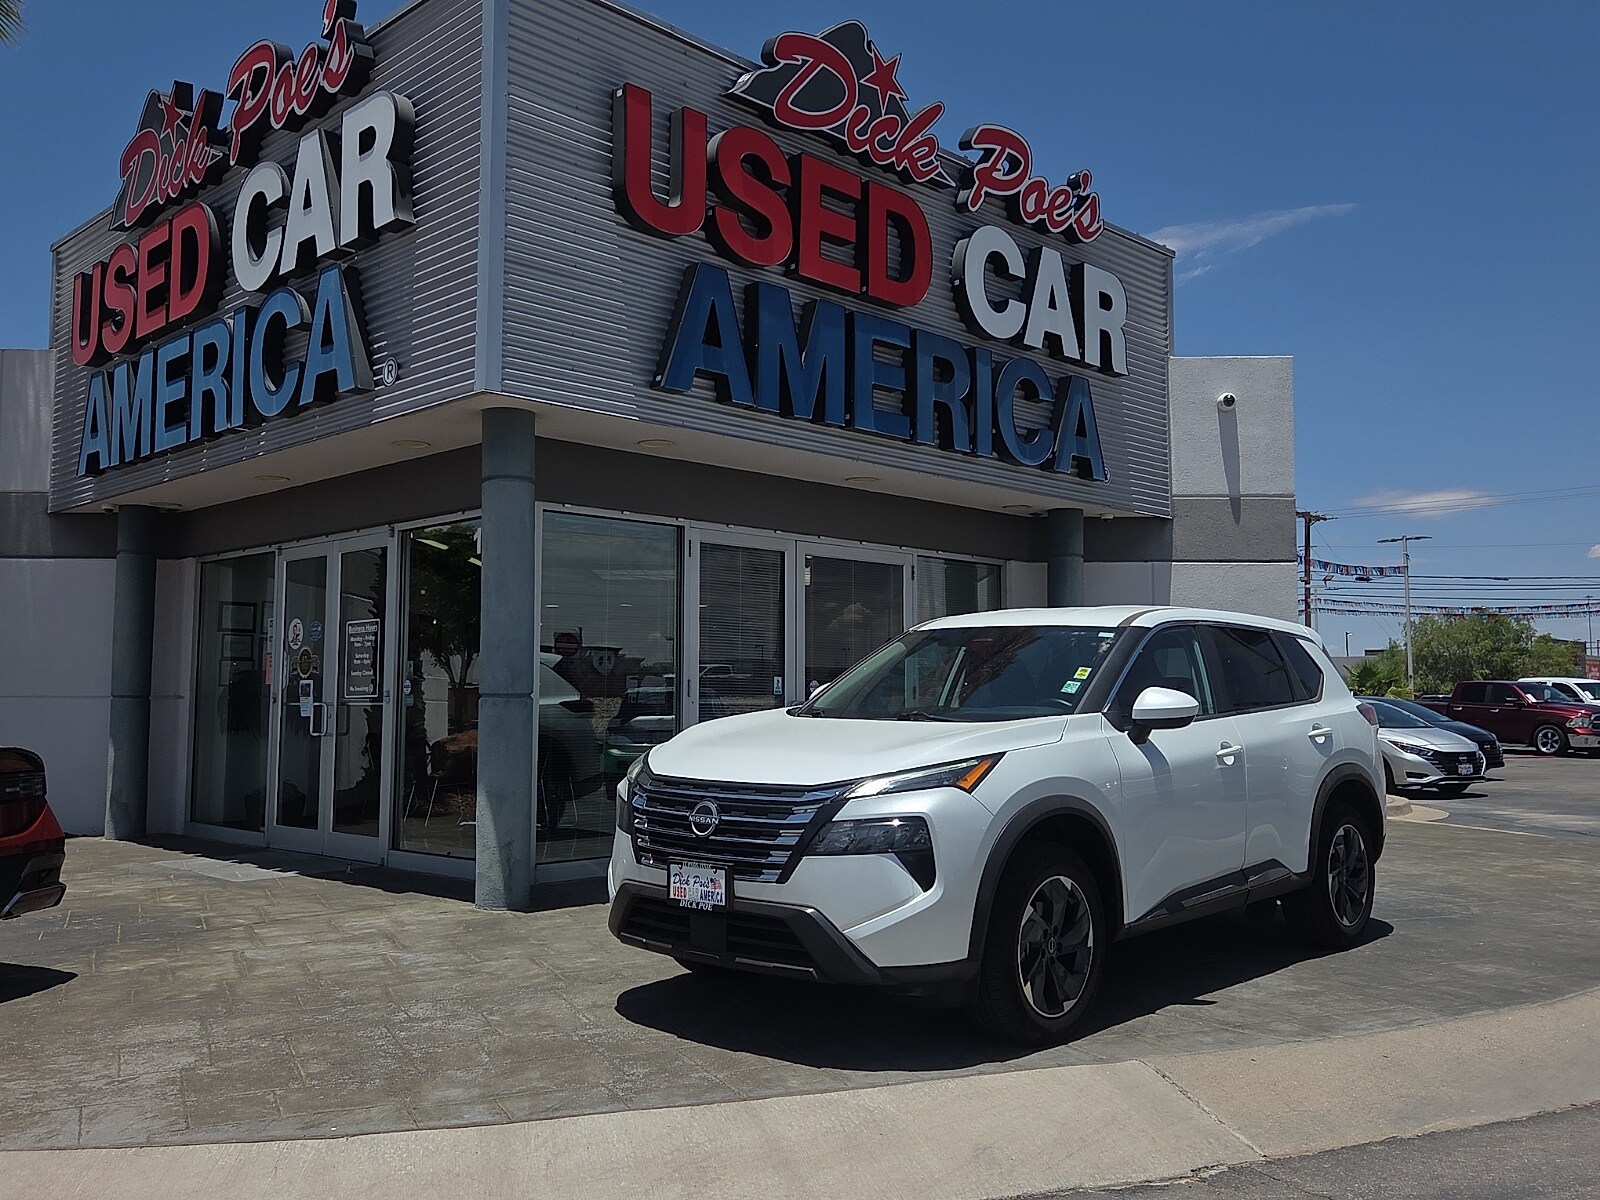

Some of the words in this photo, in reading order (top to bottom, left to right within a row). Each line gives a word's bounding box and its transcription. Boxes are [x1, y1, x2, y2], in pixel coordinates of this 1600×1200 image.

[120, 89, 211, 227] Dick
[227, 0, 355, 166] Poe's
[773, 31, 945, 182] Dick
[967, 124, 1104, 242] Poe's
[72, 201, 211, 367] USED
[231, 90, 396, 293] CAR
[623, 83, 933, 308] USED
[964, 226, 1129, 376] CAR
[77, 263, 358, 477] AMERICA
[662, 262, 1107, 481] AMERICA
[348, 625, 365, 634] Business
[672, 872, 691, 886] Dick
[692, 875, 711, 889] Poe's
[672, 886, 687, 899] USED
[700, 889, 724, 904] AMERICA
[679, 899, 698, 909] DICK
[698, 902, 714, 911] POE
[689, 815, 719, 825] NISSAN
